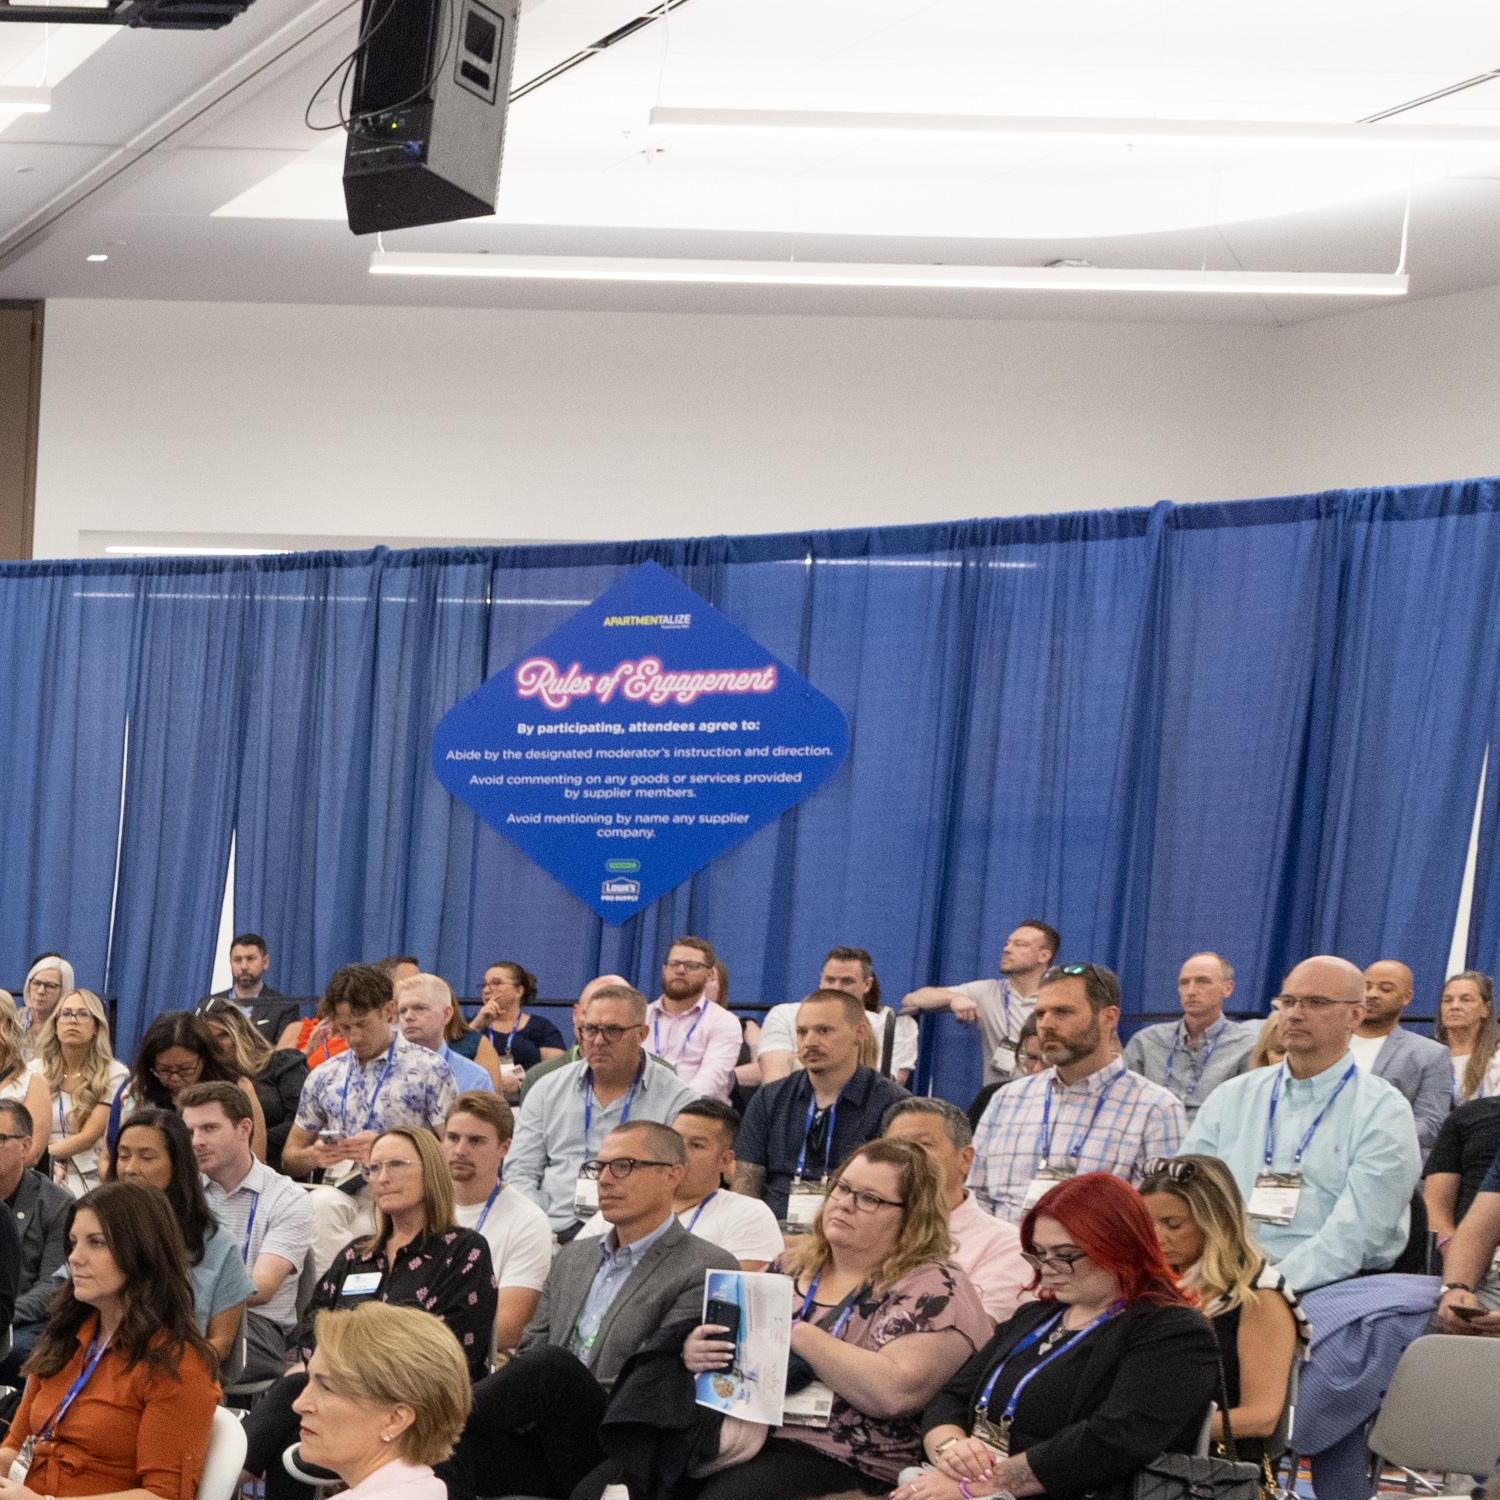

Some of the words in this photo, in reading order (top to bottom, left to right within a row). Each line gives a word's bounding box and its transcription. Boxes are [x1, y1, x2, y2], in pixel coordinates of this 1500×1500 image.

[603, 614, 692, 626] APARTMENTALIZE
[516, 657, 595, 709] Rules
[594, 662, 634, 702] of
[622, 658, 776, 704] Engagement
[516, 722, 535, 735] By
[536, 722, 626, 735] participating,
[628, 720, 695, 732] attendees
[698, 722, 738, 733] agree
[741, 720, 761, 731] to:
[446, 750, 482, 760] Abide
[484, 749, 500, 761] by
[502, 749, 523, 760] the
[525, 748, 593, 761] designated
[674, 746, 741, 758] instruction
[744, 746, 769, 757] and
[772, 745, 833, 757] direction.
[469, 774, 504, 785] Avoid
[506, 774, 582, 786] commenting
[585, 776, 601, 784] on
[604, 776, 627, 786] any
[630, 773, 669, 785] goods
[672, 774, 687, 784] or
[690, 773, 741, 784] services
[744, 772, 802, 784] provided
[564, 788, 580, 799] by
[583, 788, 632, 799] supplier
[635, 787, 696, 798] members.
[506, 813, 541, 824] Avoid
[544, 812, 613, 825] mentioning
[616, 814, 632, 825] by
[634, 814, 670, 824] name
[672, 814, 695, 825] any
[698, 812, 750, 824] supplier
[596, 828, 656, 838] company.
